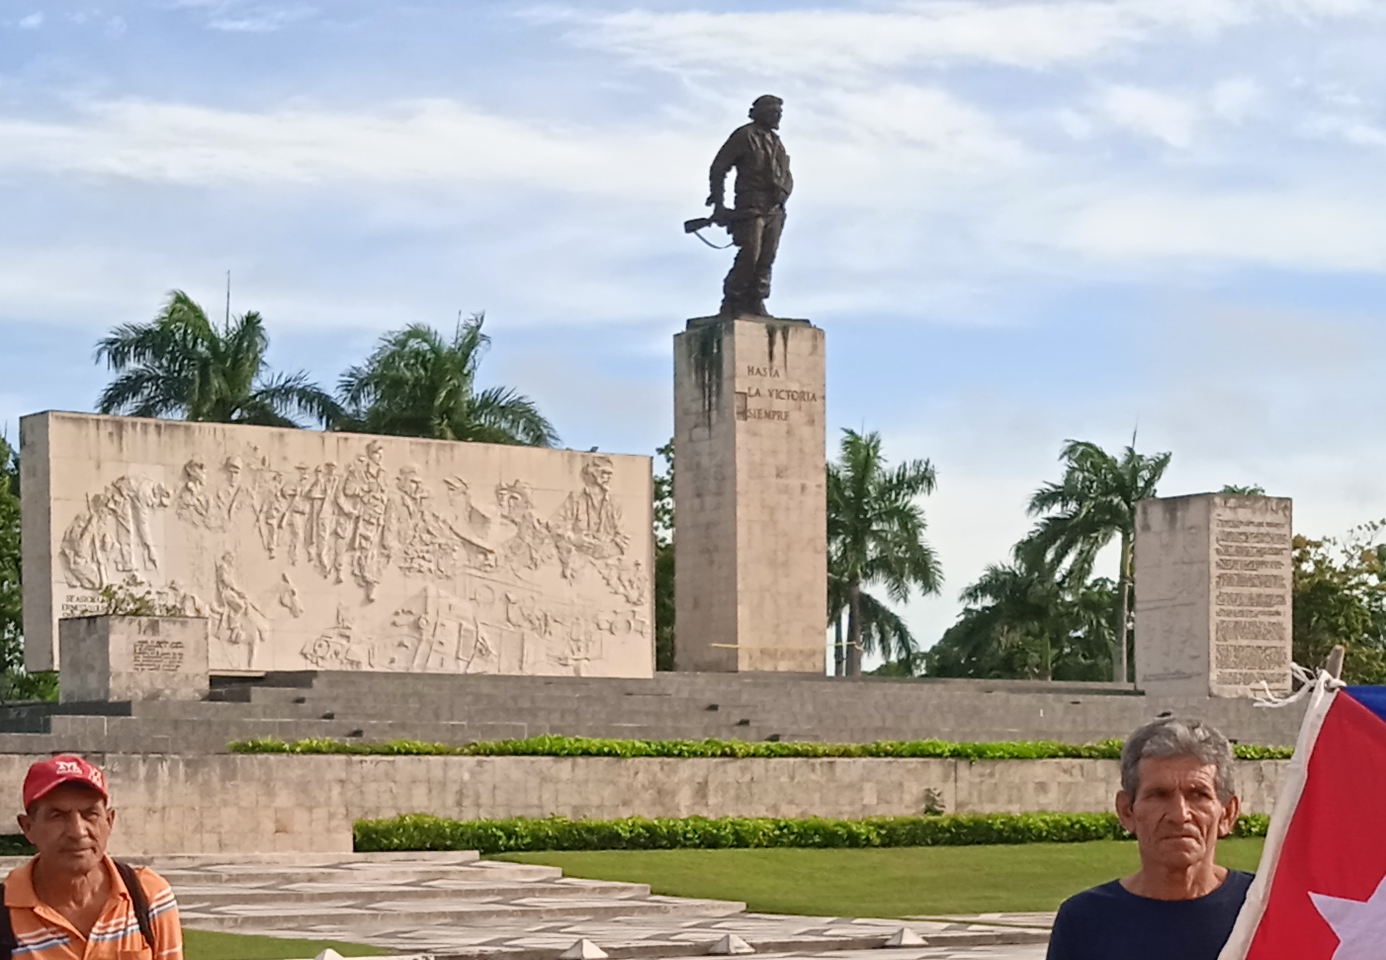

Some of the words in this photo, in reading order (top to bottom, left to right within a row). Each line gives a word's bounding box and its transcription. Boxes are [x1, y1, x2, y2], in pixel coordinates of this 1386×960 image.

[747, 365, 780, 378] HASTA
[747, 386, 761, 398] LA
[767, 388, 818, 402] VICTORIA
[747, 408, 789, 421] SIEMPRE
